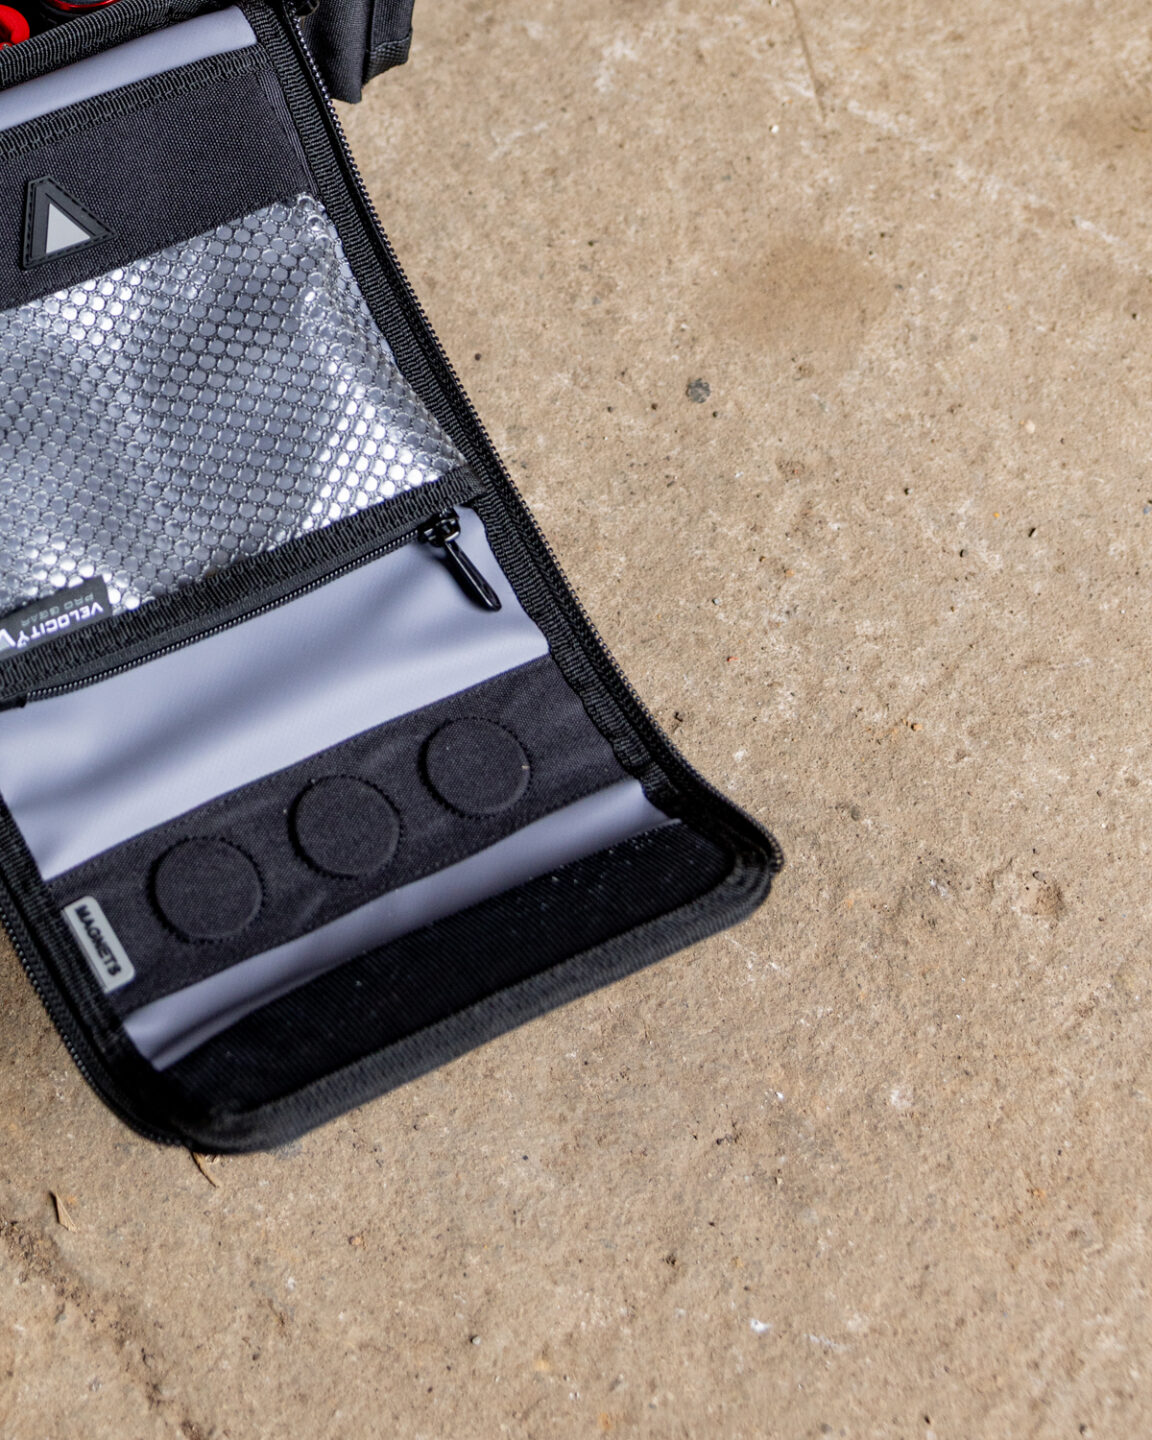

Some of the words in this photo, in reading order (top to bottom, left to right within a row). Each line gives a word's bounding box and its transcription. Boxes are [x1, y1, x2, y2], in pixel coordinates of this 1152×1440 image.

[20, 605, 62, 628] GEAR
[63, 593, 95, 610] PRO
[16, 601, 104, 649] VELOCITY
[74, 903, 123, 977] MAGNETS
